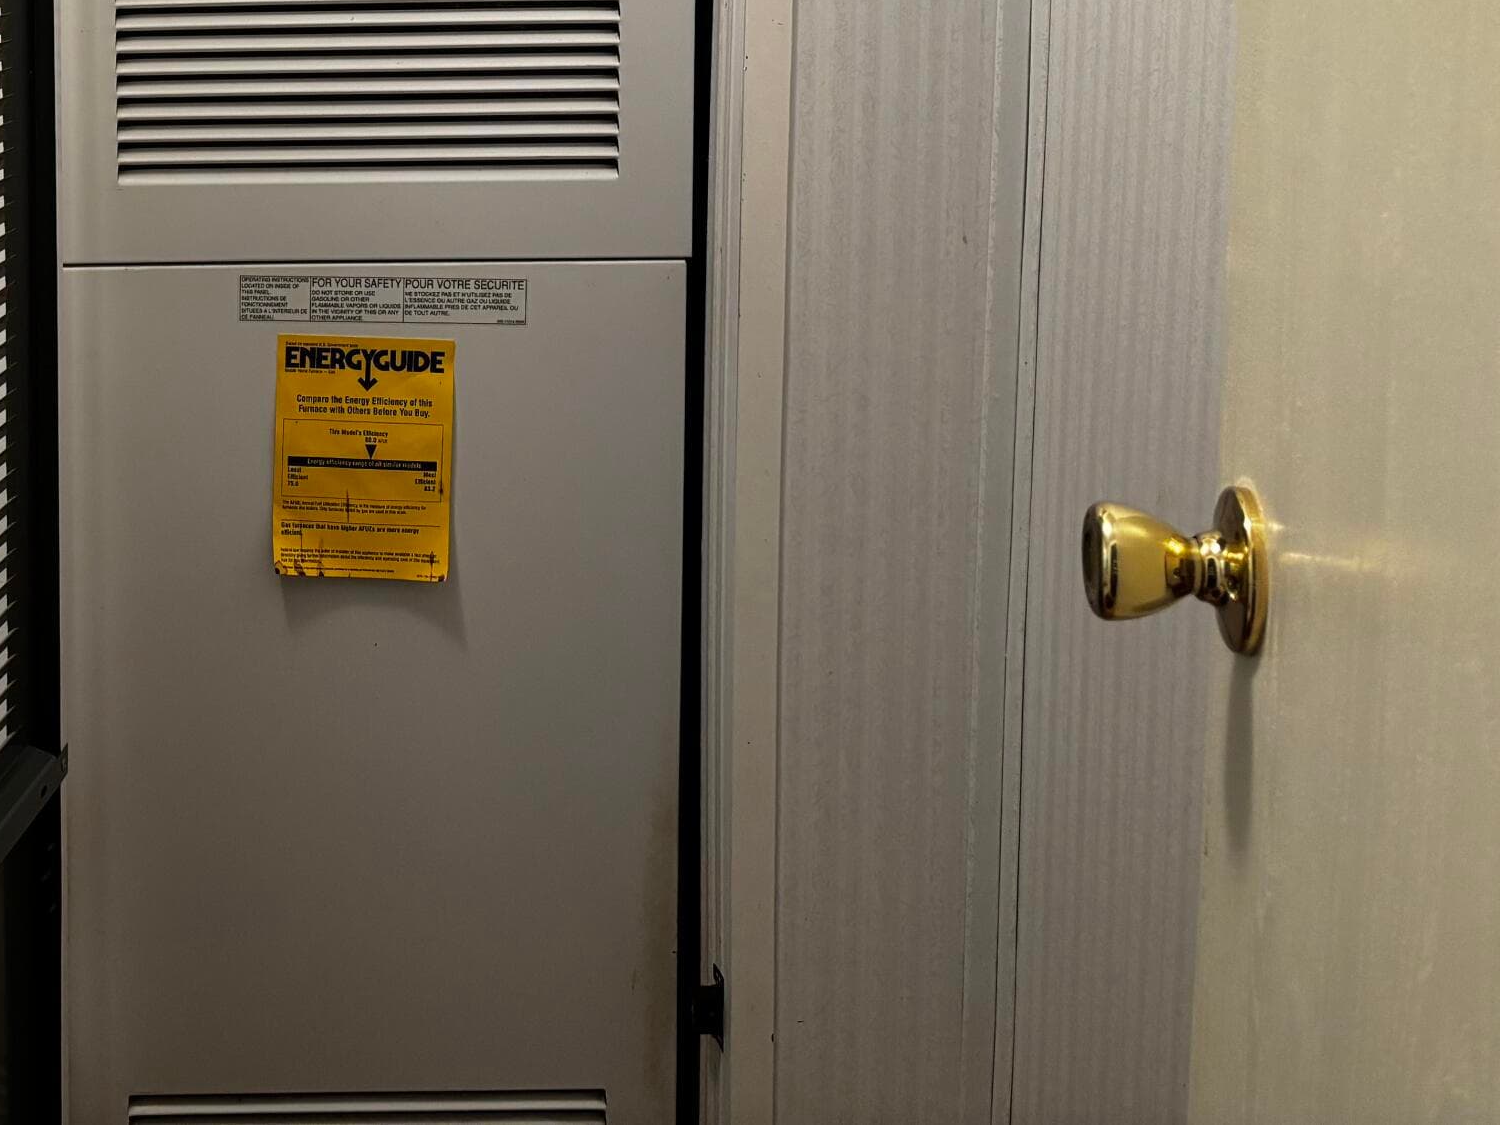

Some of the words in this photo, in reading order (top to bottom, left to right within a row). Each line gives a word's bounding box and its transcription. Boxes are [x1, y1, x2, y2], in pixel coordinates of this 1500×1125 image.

[312, 278, 332, 288] FOR
[335, 278, 363, 288] YOUR
[364, 278, 402, 289] SAFETY
[405, 279, 434, 289] POUR
[437, 280, 471, 290] VOTRE
[474, 280, 525, 291] SECURITE
[285, 346, 446, 374] ENERGYGUIDE
[297, 394, 329, 405] Compare
[331, 396, 342, 404] the
[345, 396, 370, 407] Energy
[372, 397, 408, 408] Efficiency
[410, 398, 417, 407] of
[419, 399, 433, 407] this
[298, 404, 328, 413] Furnace
[330, 405, 345, 414] with
[348, 406, 371, 415] Others
[373, 407, 397, 416] Before
[400, 408, 413, 417] You
[415, 409, 431, 419] Buy.
[363, 430, 389, 438] Efficiency
[307, 458, 326, 467] Energy
[326, 459, 351, 468] efficiency
[352, 461, 369, 469] range
[383, 460, 402, 468] similar
[341, 524, 357, 532] higher
